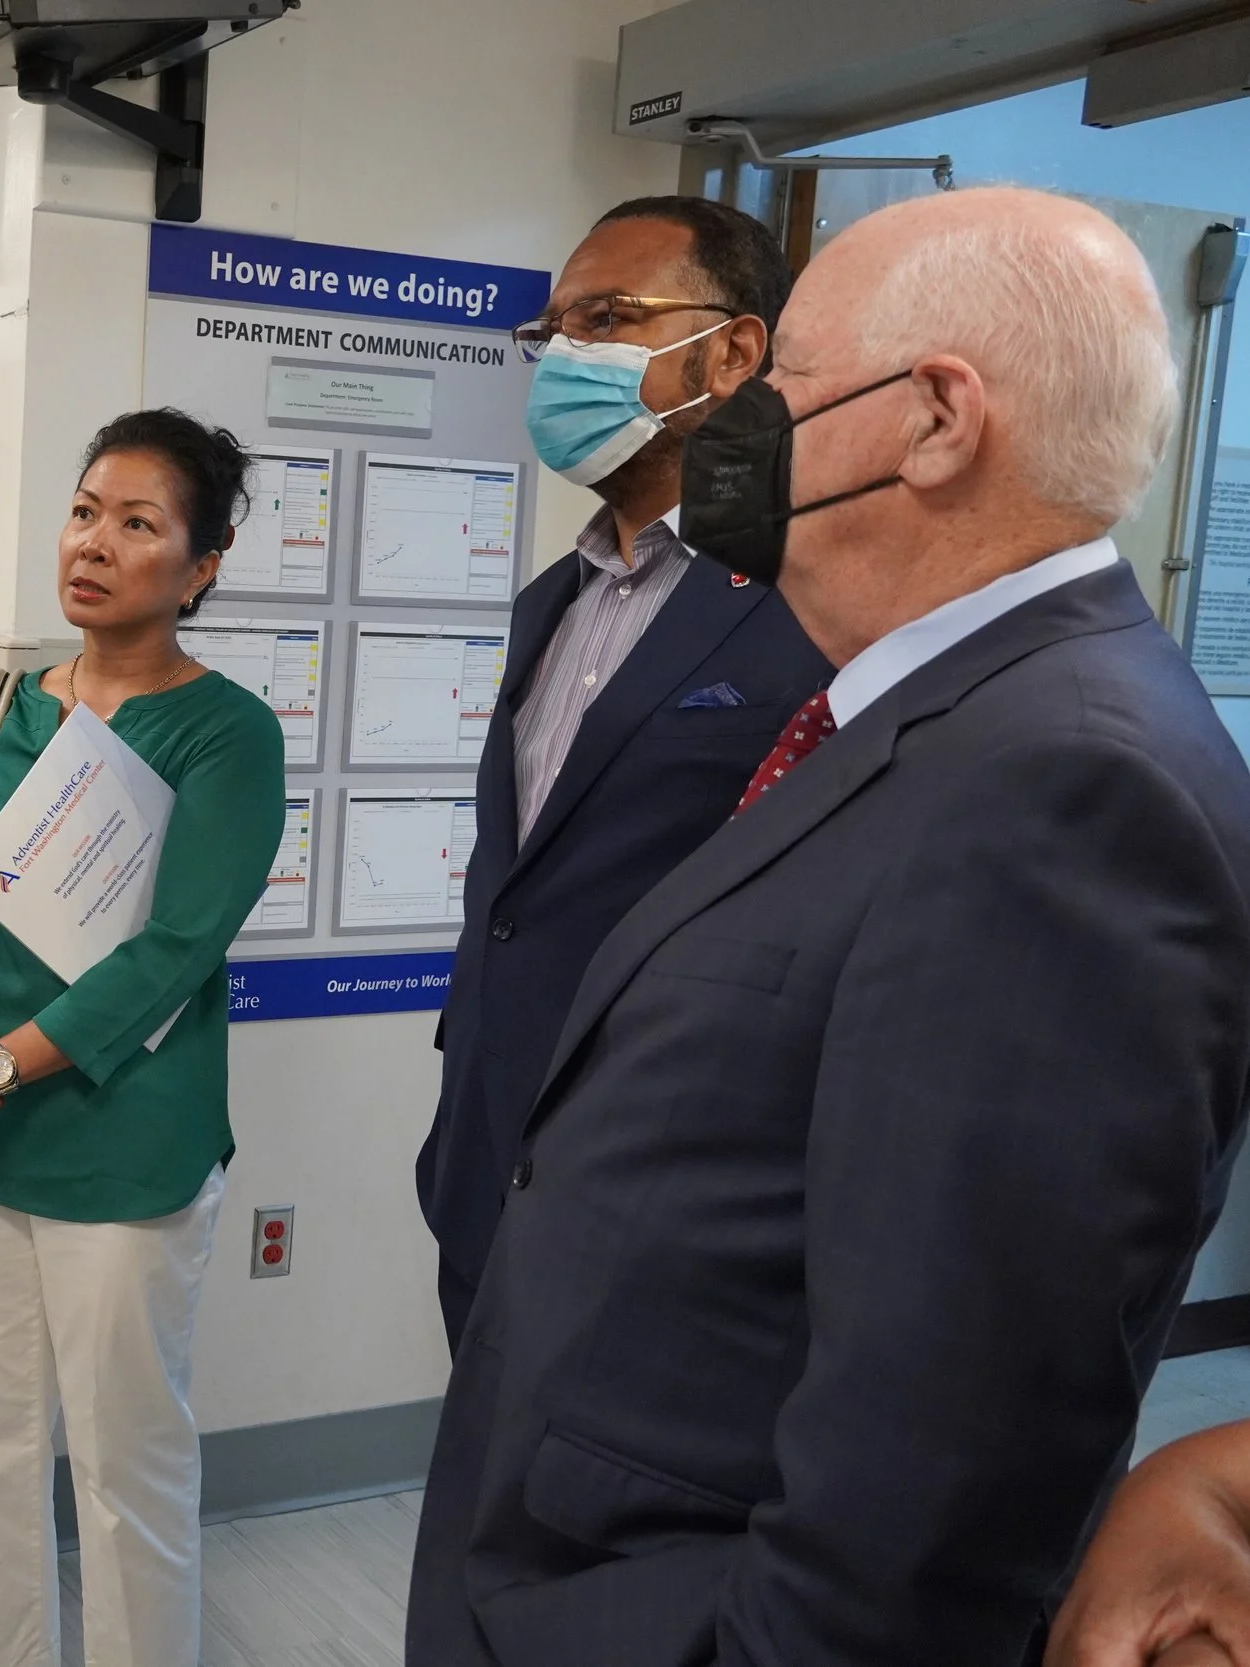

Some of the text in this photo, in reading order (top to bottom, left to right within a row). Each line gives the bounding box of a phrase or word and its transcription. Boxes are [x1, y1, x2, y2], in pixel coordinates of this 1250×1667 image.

[631, 96, 680, 121] STANLEY
[210, 251, 498, 317] How are we doing?
[196, 318, 505, 366] DEPARTMENT COMMUNICATION
[343, 382, 358, 390] Main
[359, 383, 375, 393] Thing
[12, 818, 50, 867] Adventist
[47, 761, 92, 819] HealthCare
[19, 759, 106, 873] Fort Washington Medical Center
[54, 886, 62, 895] We
[61, 871, 74, 887] extend
[81, 851, 89, 861] care
[87, 834, 101, 852] through
[100, 826, 108, 836] the
[81, 859, 94, 876] mental
[92, 851, 101, 861] and
[85, 910, 93, 920] will
[91, 896, 105, 913] provide
[124, 853, 137, 871] patient
[105, 896, 116, 909] every
[126, 869, 138, 882] every
[326, 974, 452, 994] Our Journey to Worl
